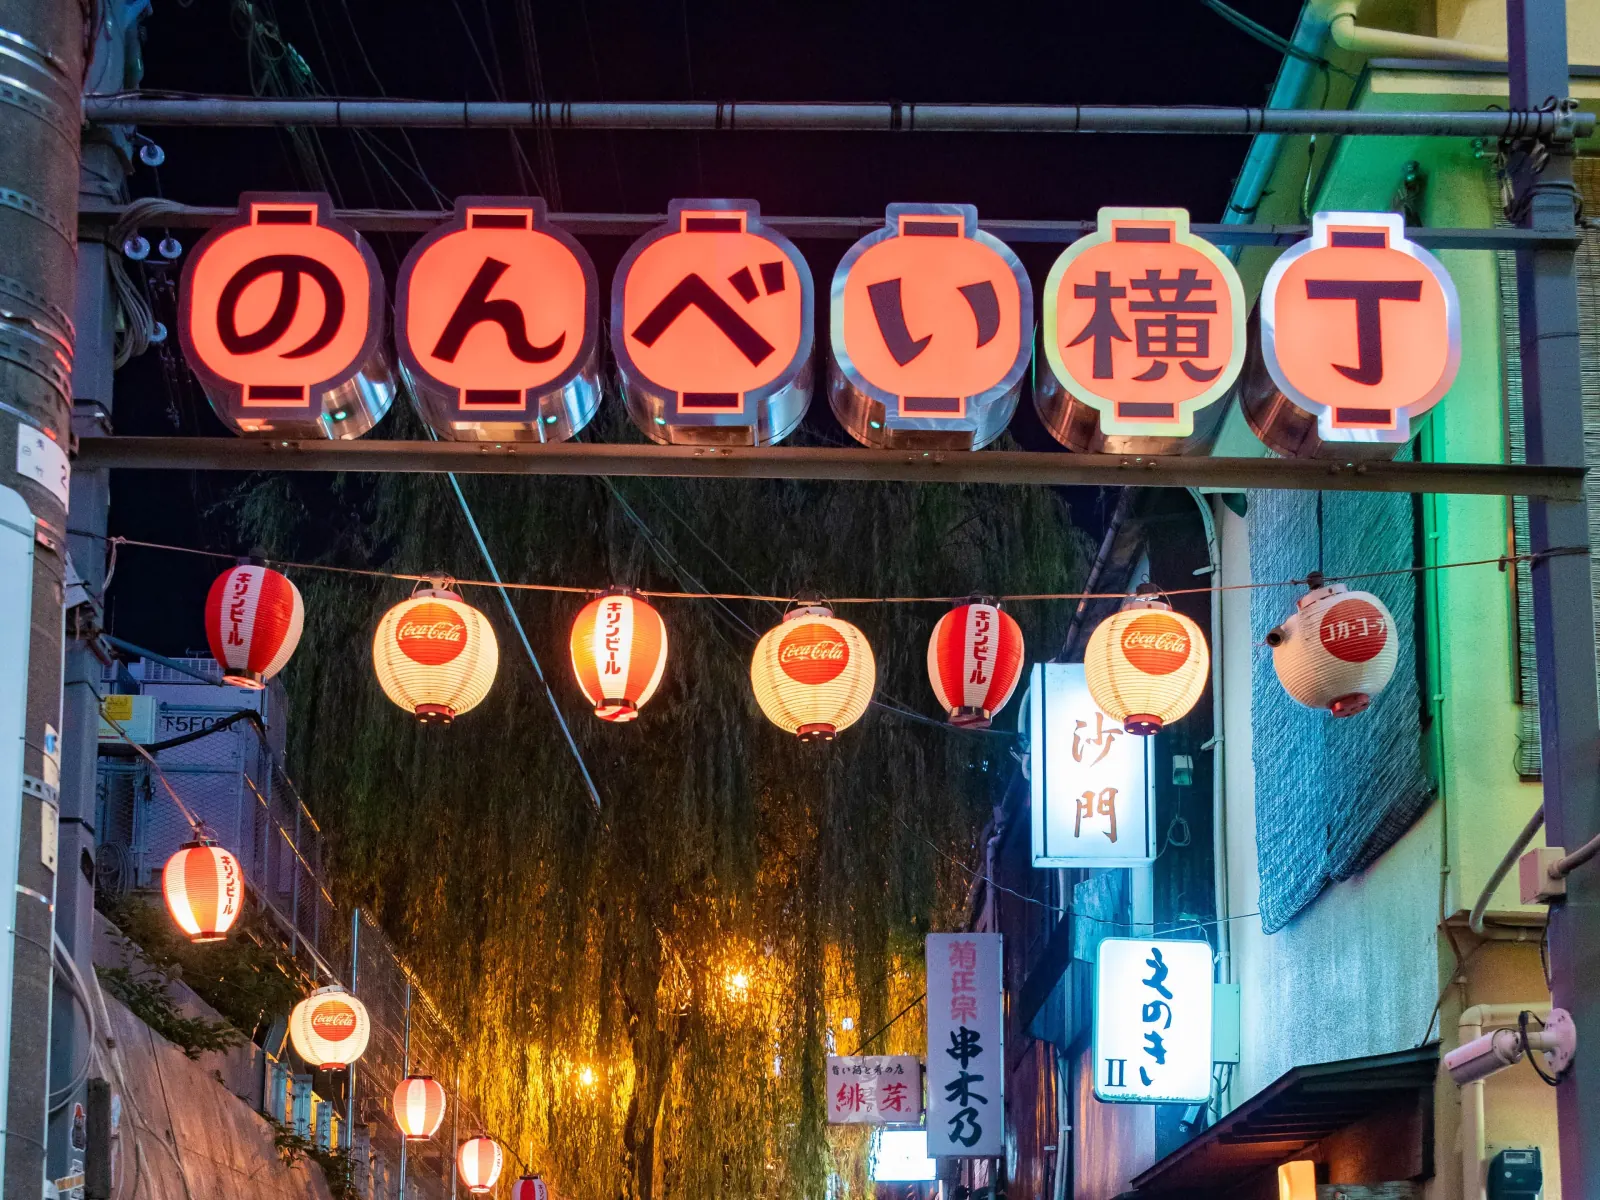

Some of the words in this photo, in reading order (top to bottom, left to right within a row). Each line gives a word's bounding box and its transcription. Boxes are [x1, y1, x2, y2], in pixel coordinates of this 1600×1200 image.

[216, 254, 1423, 386] のんべい横丁
[228, 571, 253, 647] キリンビール
[397, 620, 465, 643] Coca-Cola
[604, 601, 623, 676] キリンビール
[1124, 630, 1190, 654] Coca-Cola
[781, 639, 847, 663] Coca-Cola
[969, 609, 991, 685] キリンビール
[1071, 711, 1124, 844] 沙門
[220, 855, 236, 916] キリンビール
[313, 1012, 357, 1027] Coca-Cola
[948, 939, 978, 1025] 菊正宗
[944, 1025, 989, 1148] 串木乃
